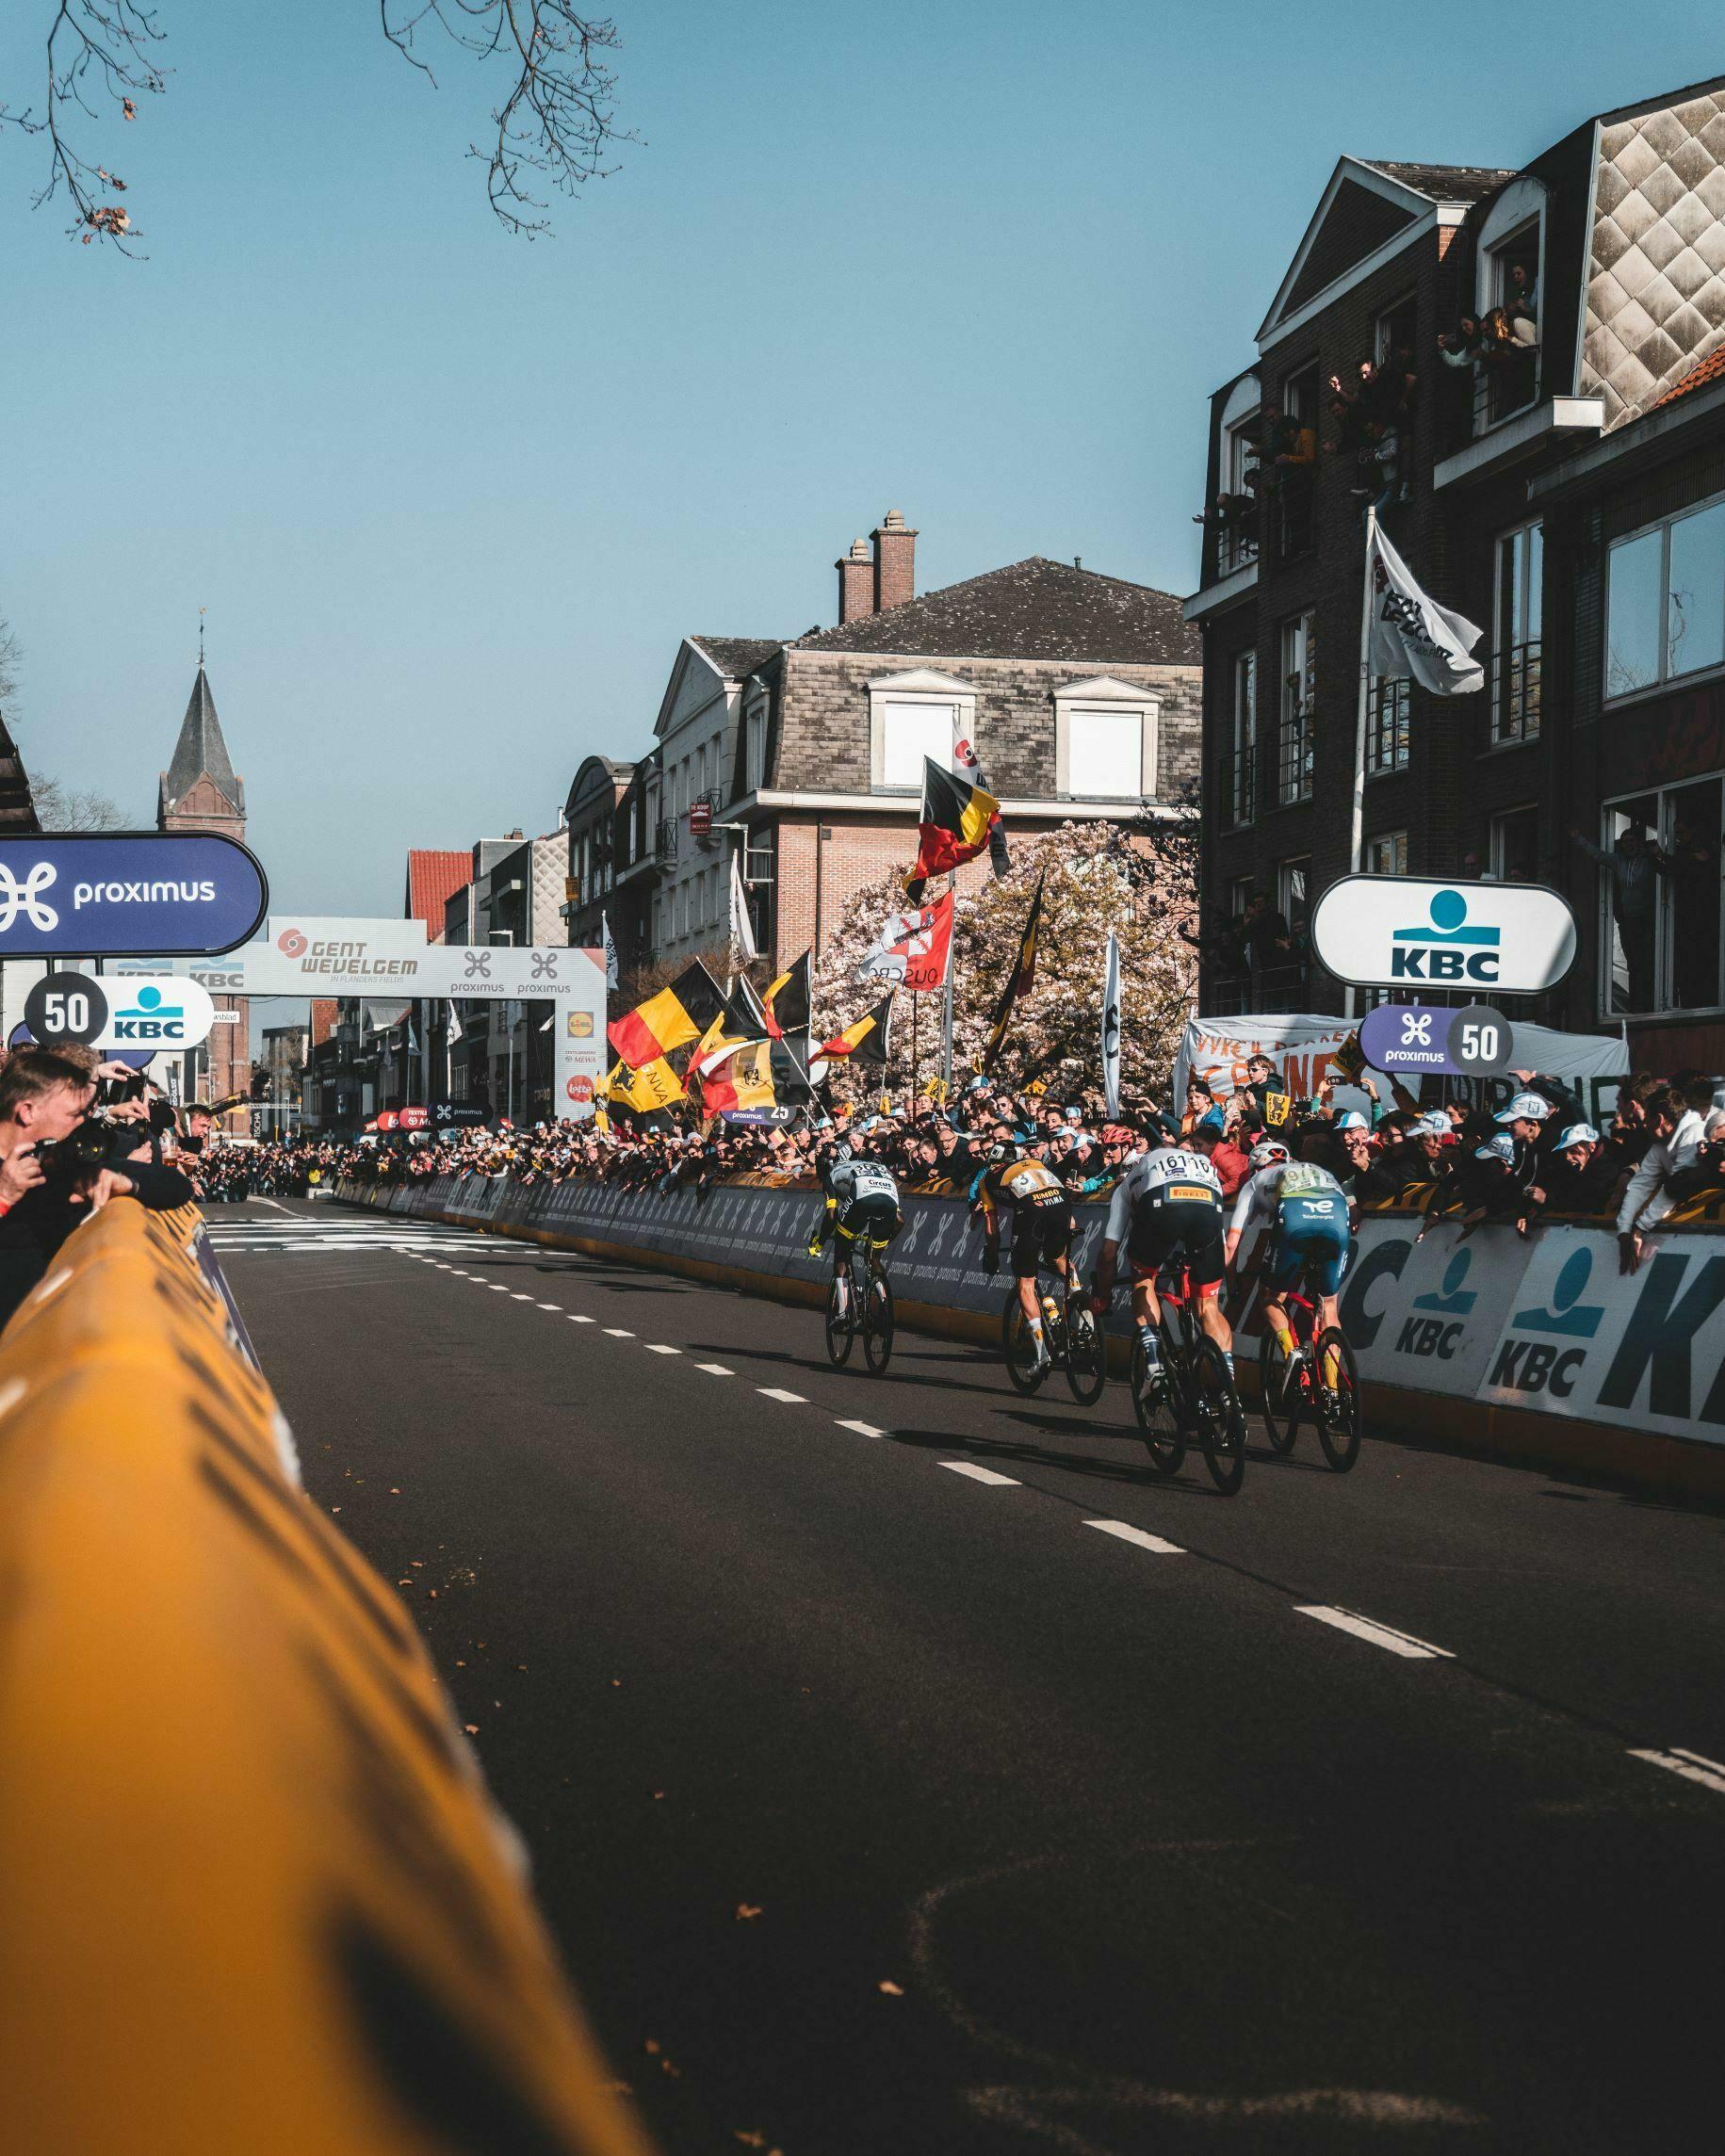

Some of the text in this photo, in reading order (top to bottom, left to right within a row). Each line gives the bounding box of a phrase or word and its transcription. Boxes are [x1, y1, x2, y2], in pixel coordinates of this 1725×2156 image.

[74, 882, 215, 909] proximus
[312, 942, 367, 957] GENT
[301, 959, 417, 975] WEVELGEM
[1391, 948, 1499, 982] KBC
[189, 973, 244, 987] KBC
[450, 983, 505, 993] proximus
[517, 984, 571, 995] proximus
[44, 993, 89, 1032] 50
[114, 1022, 184, 1039] KBC
[1461, 1024, 1498, 1062] 50
[1386, 1050, 1445, 1063] proximus
[1159, 1156, 1187, 1172] 161
[1019, 1174, 1029, 1185] 3
[1033, 1189, 1060, 1201] JUMBO
[1044, 1195, 1065, 1206] VISMA
[1394, 1316, 1463, 1360] KBC
[1488, 1339, 1587, 1398] KBC
